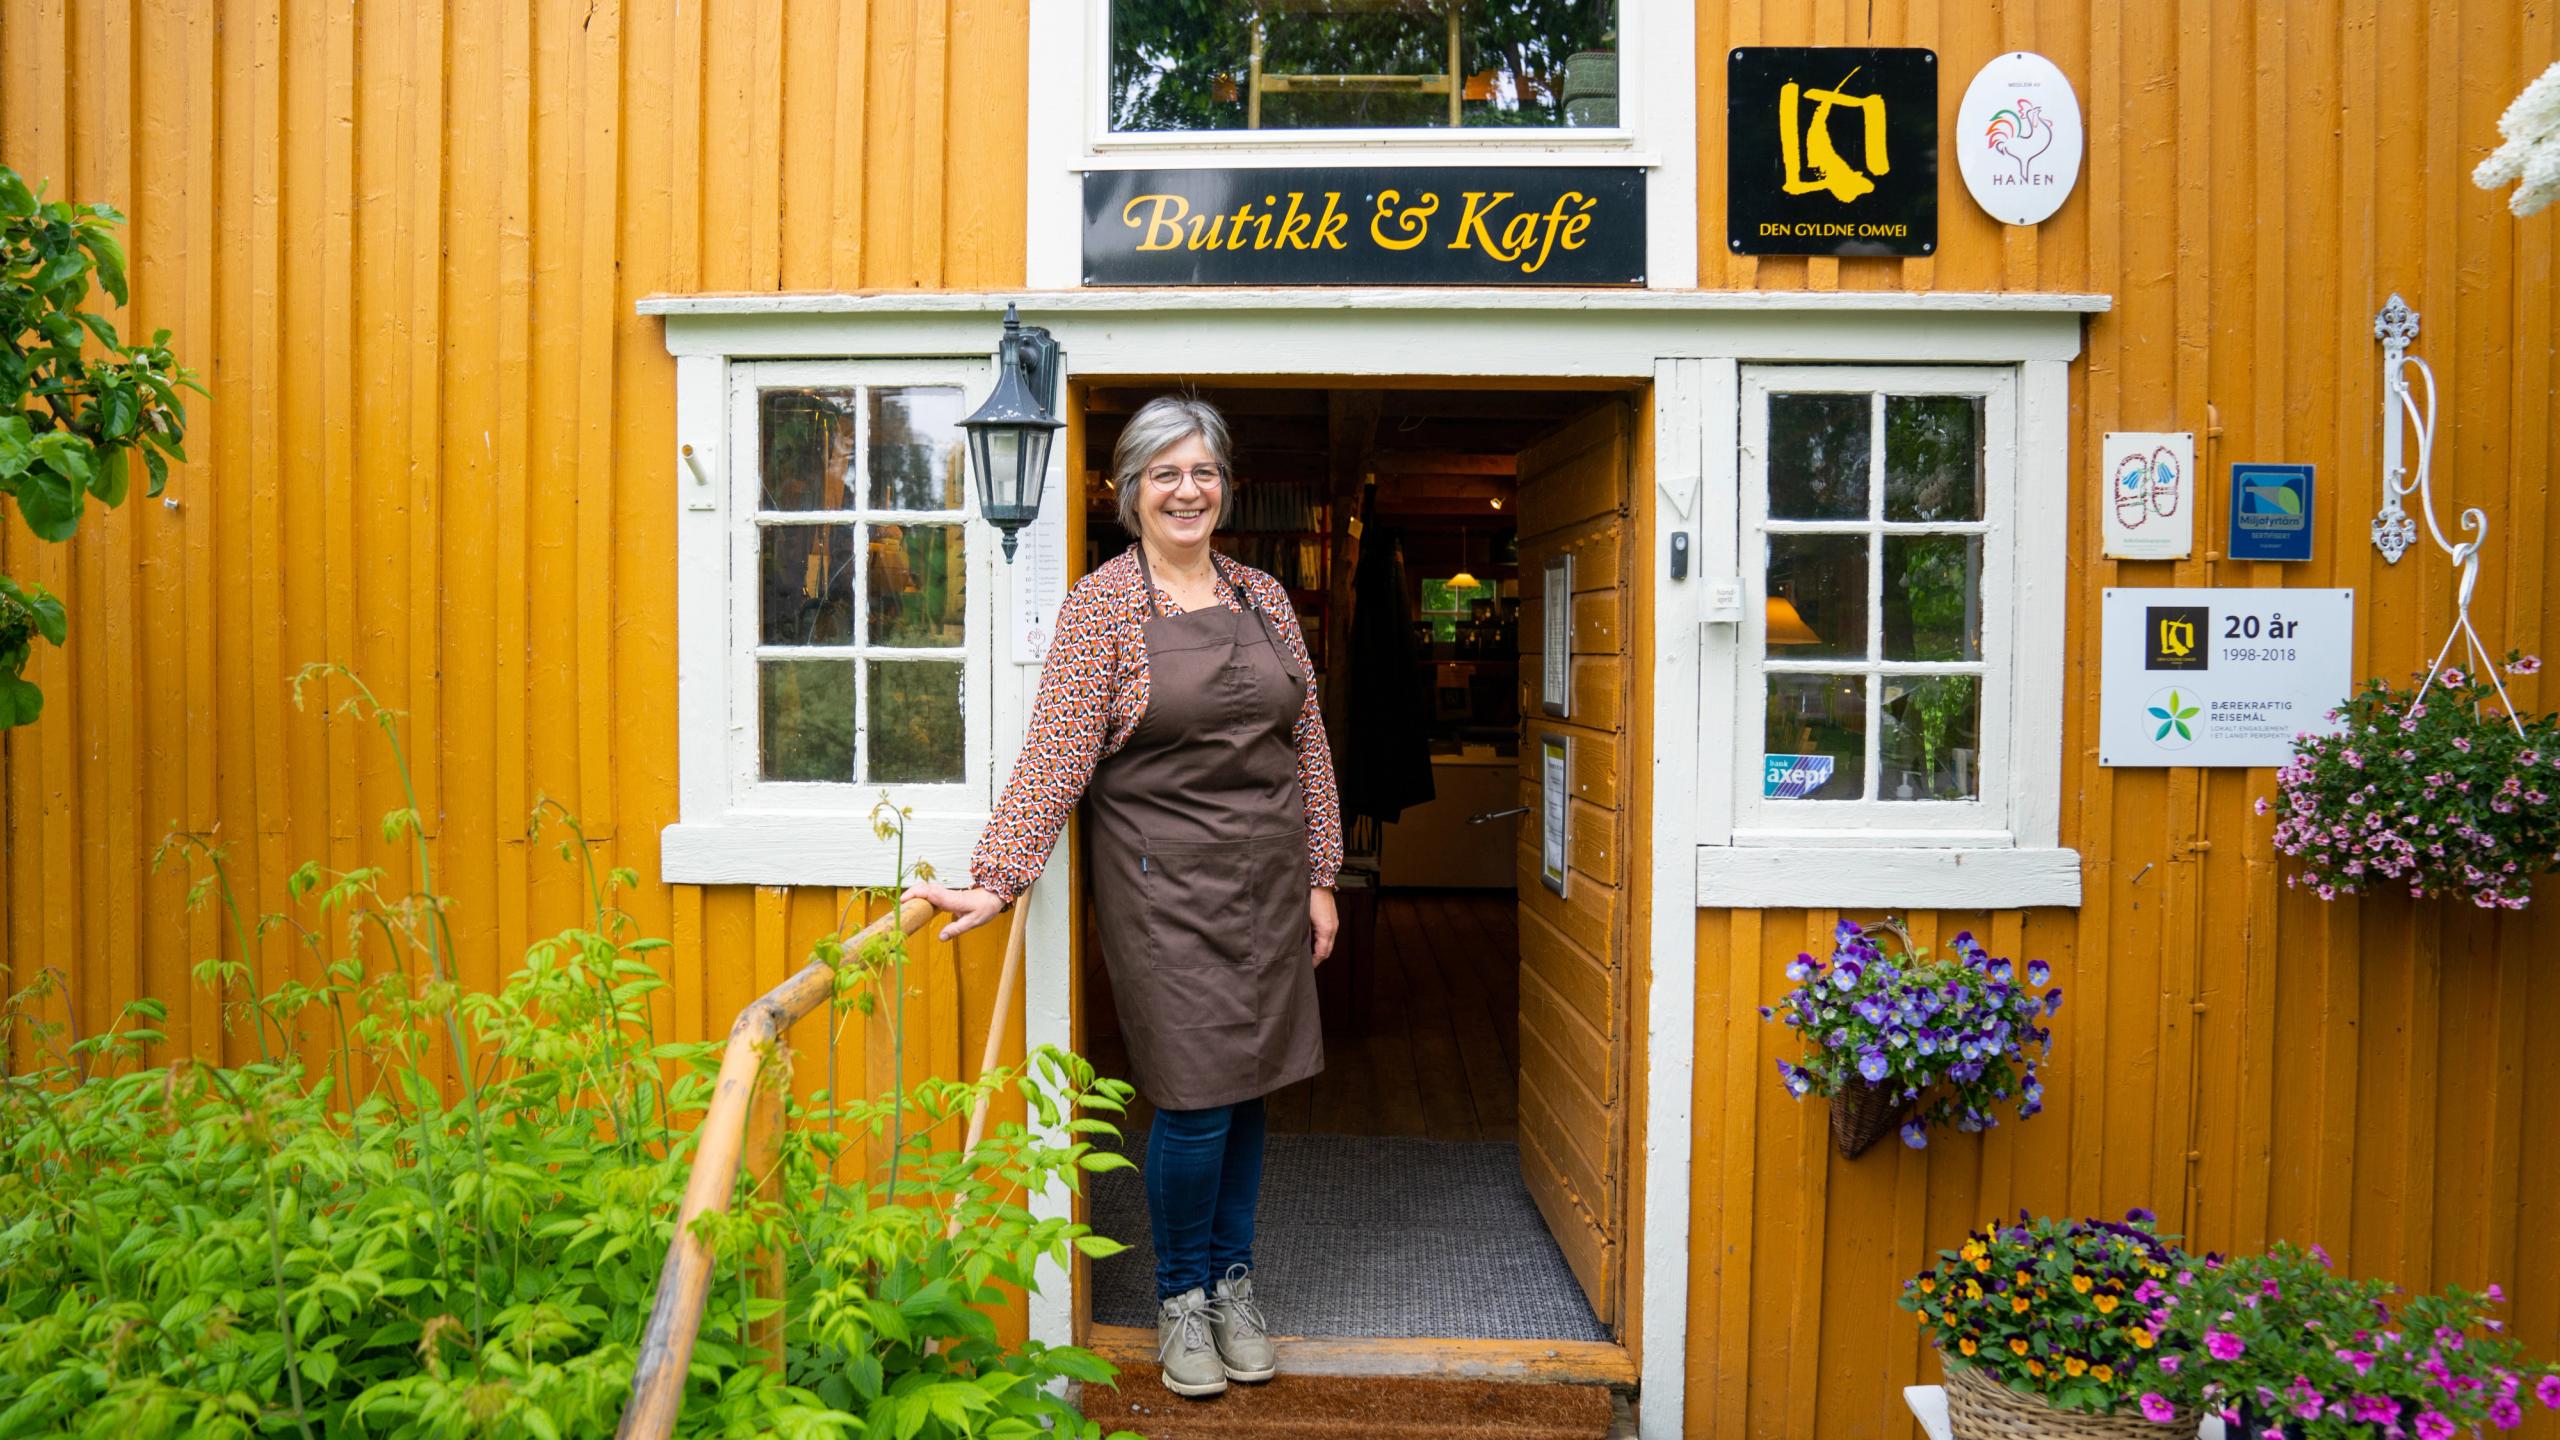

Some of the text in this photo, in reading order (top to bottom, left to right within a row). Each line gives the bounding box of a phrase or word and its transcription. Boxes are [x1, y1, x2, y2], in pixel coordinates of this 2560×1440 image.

[1992, 173, 2054, 186] HANEN
[1123, 189, 1598, 273] Butikk & Kafé
[1759, 223, 1907, 237] DEN GYLDNE OMVEI
[2224, 612, 2299, 639] 20 år
[2223, 648, 2296, 661] 1998-2018
[2211, 701, 2293, 710] BÆREKRAFTIG
[2211, 712, 2266, 722] REISEMÅL
[1766, 766, 1828, 791] axept
